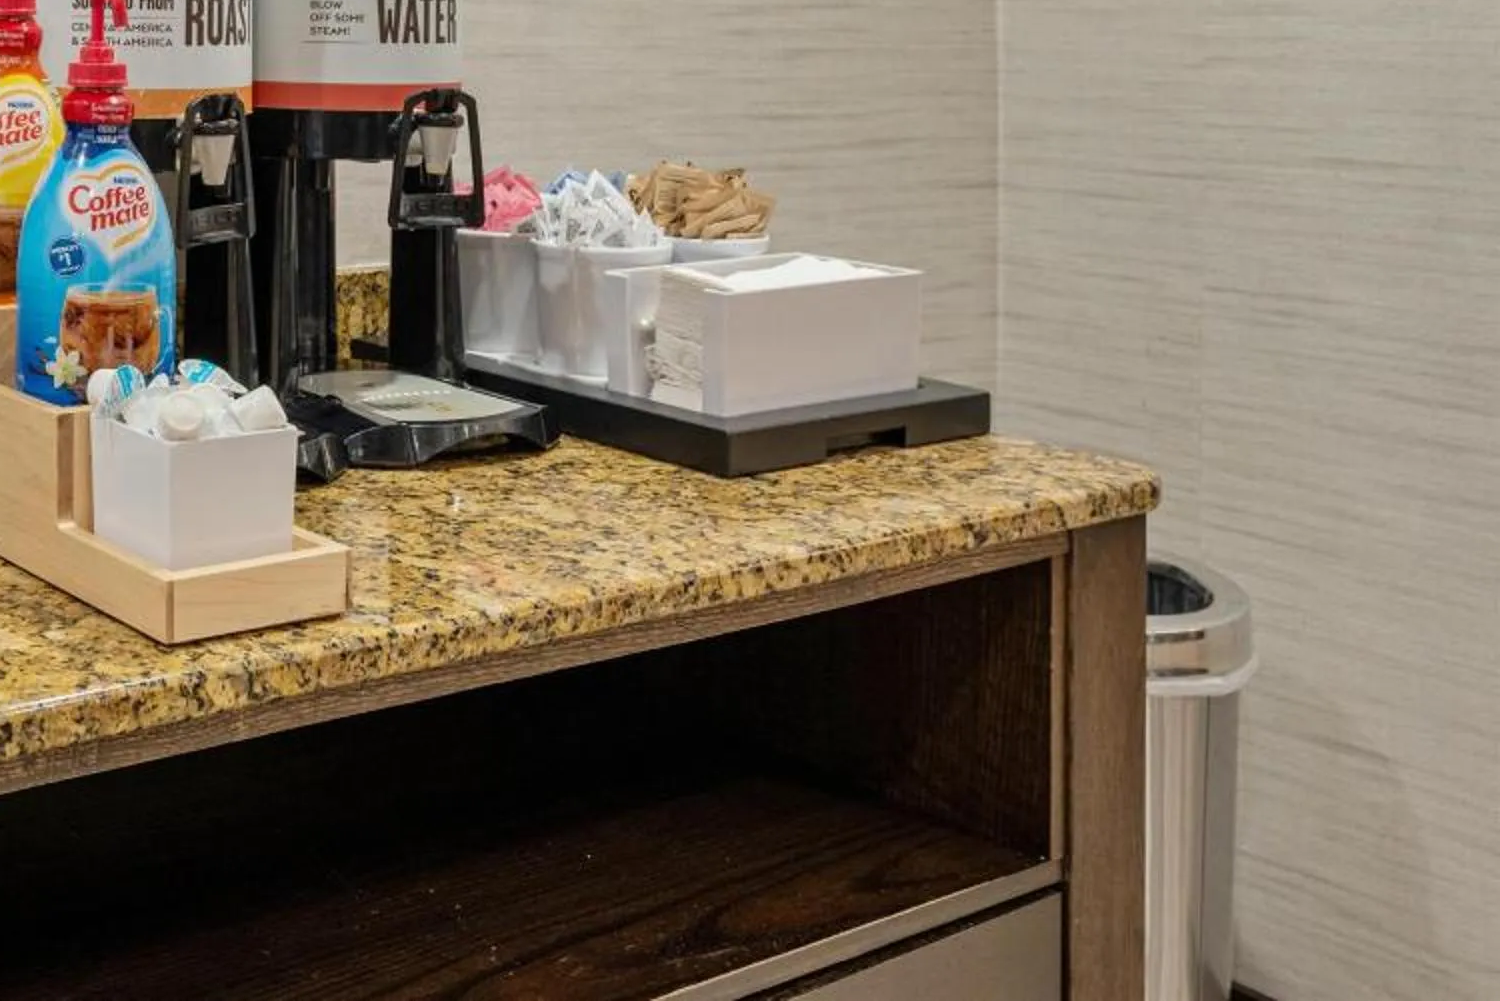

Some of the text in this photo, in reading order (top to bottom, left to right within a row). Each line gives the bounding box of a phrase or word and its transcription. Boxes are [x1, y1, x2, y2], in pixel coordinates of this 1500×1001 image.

[310, 0, 343, 9] BLOW
[310, 13, 365, 23] OFF SOME
[123, 37, 173, 47] AMERICA
[69, 184, 145, 215] Coffee
[91, 202, 148, 231] mate
